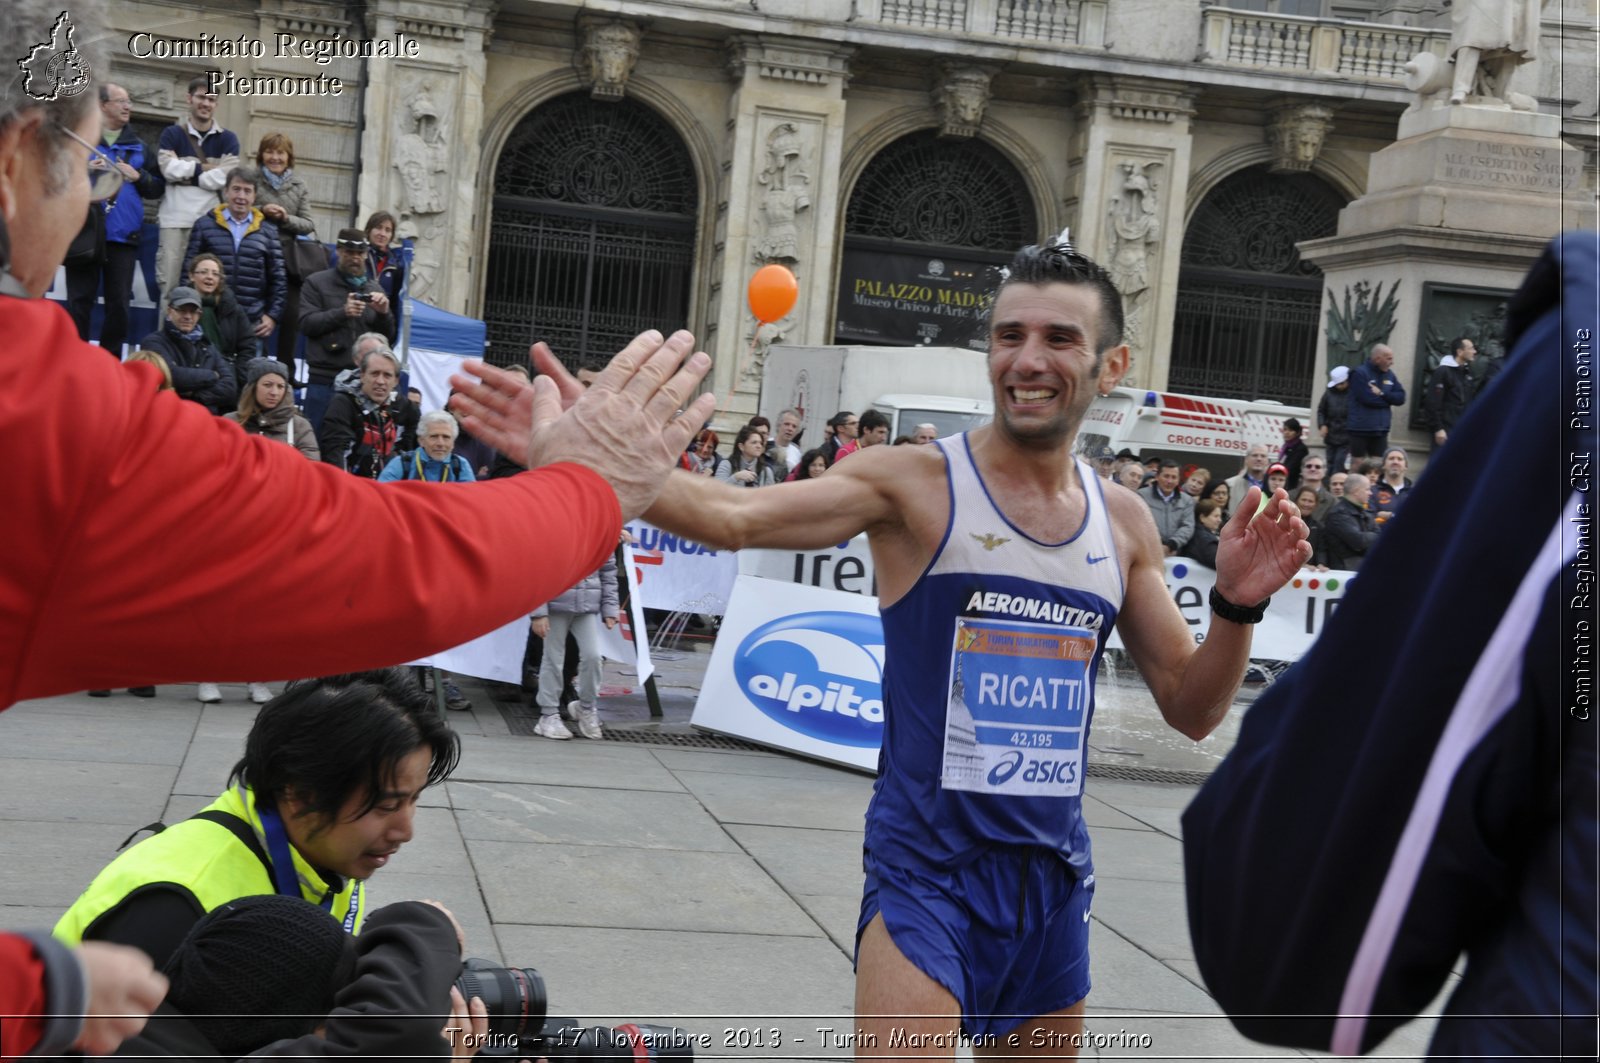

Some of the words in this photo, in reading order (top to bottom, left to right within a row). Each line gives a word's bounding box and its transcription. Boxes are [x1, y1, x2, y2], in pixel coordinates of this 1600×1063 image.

[854, 279, 932, 302] PALAZZO
[853, 294, 891, 309] Museo
[894, 299, 930, 313] Civico
[933, 303, 969, 318] d'Arte
[1167, 434, 1211, 447] CROCE
[794, 553, 878, 597] ire
[966, 591, 1104, 630] AERONAUTICA
[987, 634, 1014, 646] TURIN
[1016, 637, 1059, 649] MARATHON
[978, 672, 1082, 711] RICATTI
[1010, 732, 1052, 748] 42,195
[1022, 760, 1077, 784] asics
